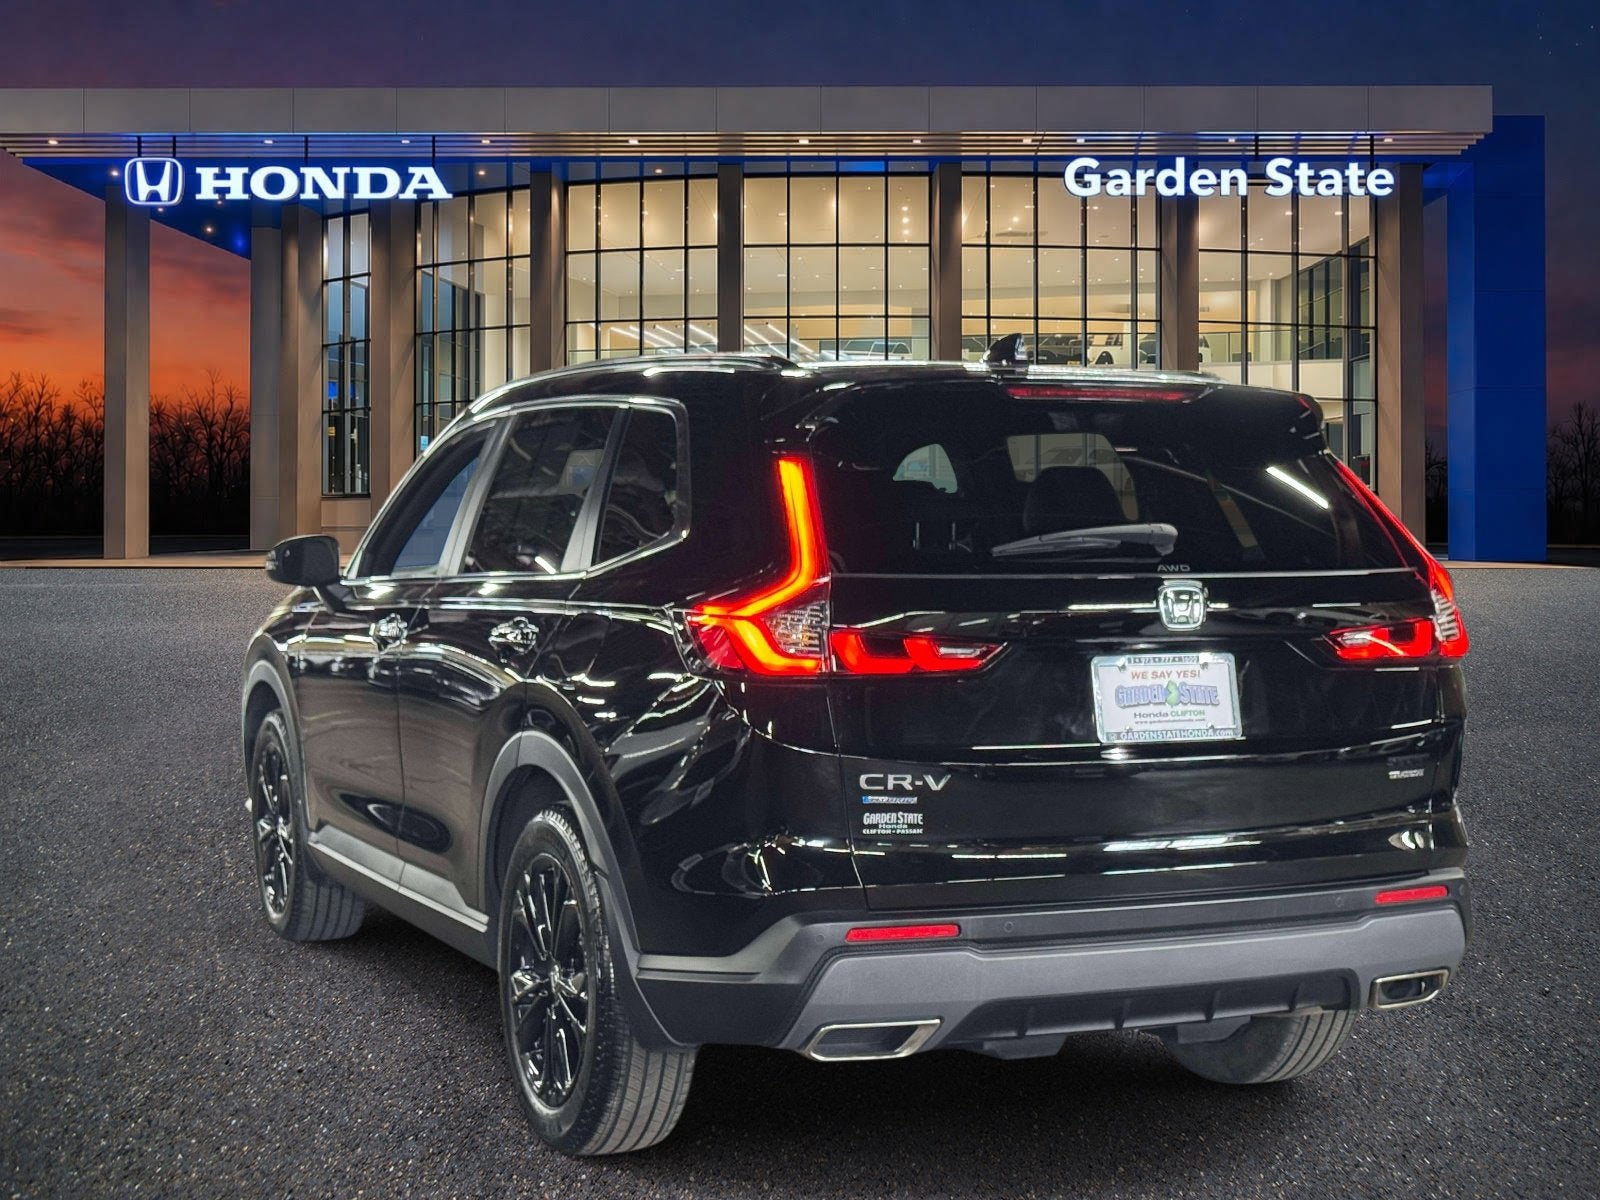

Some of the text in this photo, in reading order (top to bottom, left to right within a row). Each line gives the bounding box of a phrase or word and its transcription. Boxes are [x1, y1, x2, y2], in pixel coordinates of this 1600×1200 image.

[195, 165, 453, 200] HONDA
[1063, 156, 1395, 197] Garden State
[1157, 564, 1191, 572] AWD
[1131, 669, 1201, 680] WE SAY YES!
[1178, 681, 1220, 706] STATE
[859, 773, 952, 791] CR-V
[863, 811, 924, 825] GARDEN STATE
